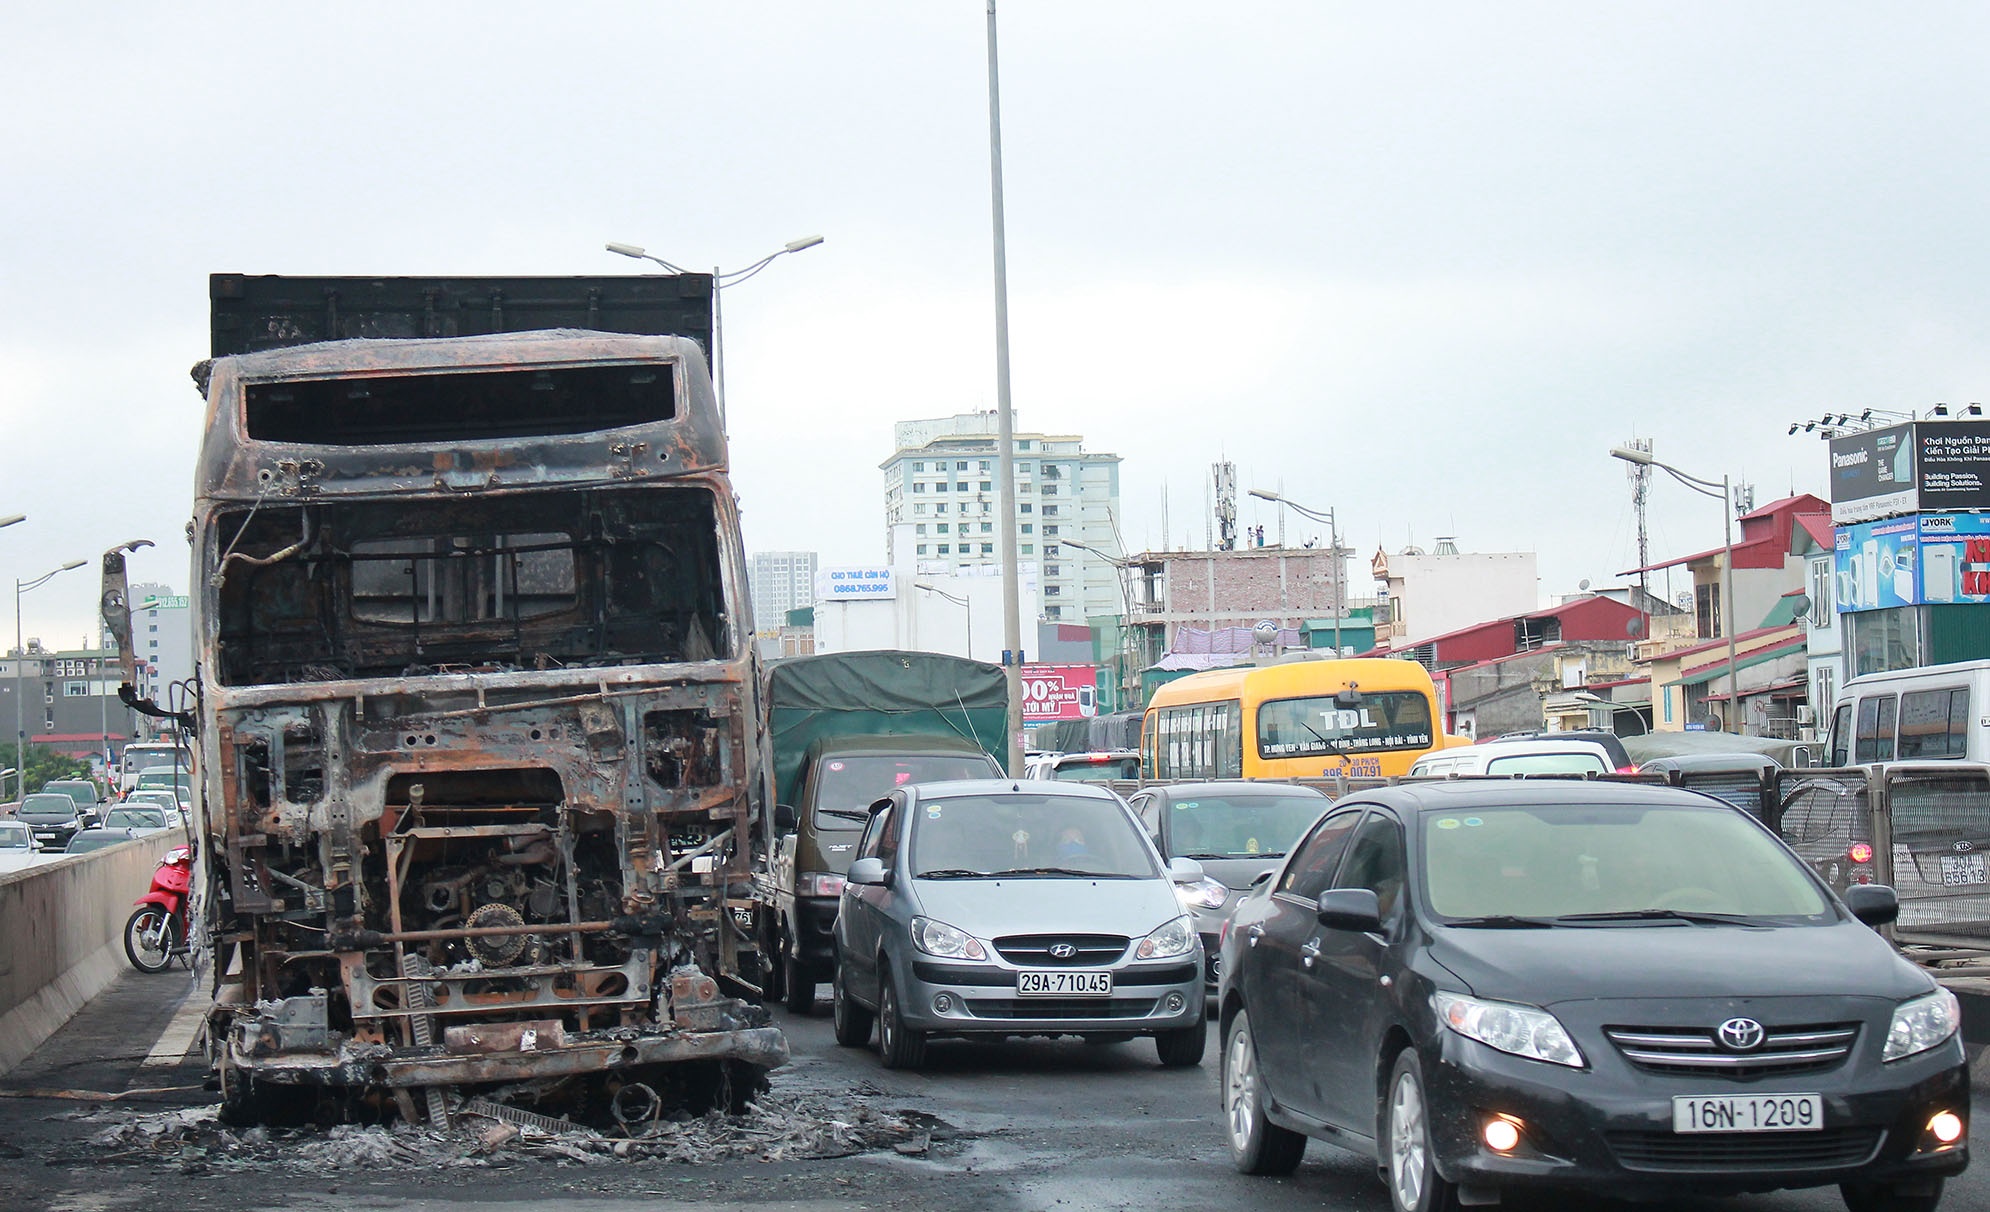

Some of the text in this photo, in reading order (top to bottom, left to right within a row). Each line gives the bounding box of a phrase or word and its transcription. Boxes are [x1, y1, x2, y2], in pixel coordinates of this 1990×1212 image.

[1945, 446, 1961, 456] Tạo
[1963, 445, 1980, 455] Giải
[1832, 447, 1869, 469] Panasonic
[1924, 473, 1950, 481] Building
[1924, 480, 1950, 488] Building
[1929, 518, 1952, 527] YORK
[831, 571, 845, 580] CHO
[846, 570, 863, 579] THUÊ
[879, 569, 890, 580] HỘ
[1041, 700, 1057, 713] MỸ
[1369, 736, 1382, 747] LONG
[1418, 732, 1429, 744] YÊN
[1021, 974, 1109, 992] 29A-710.45
[1688, 1098, 1813, 1128] 16N-1209
